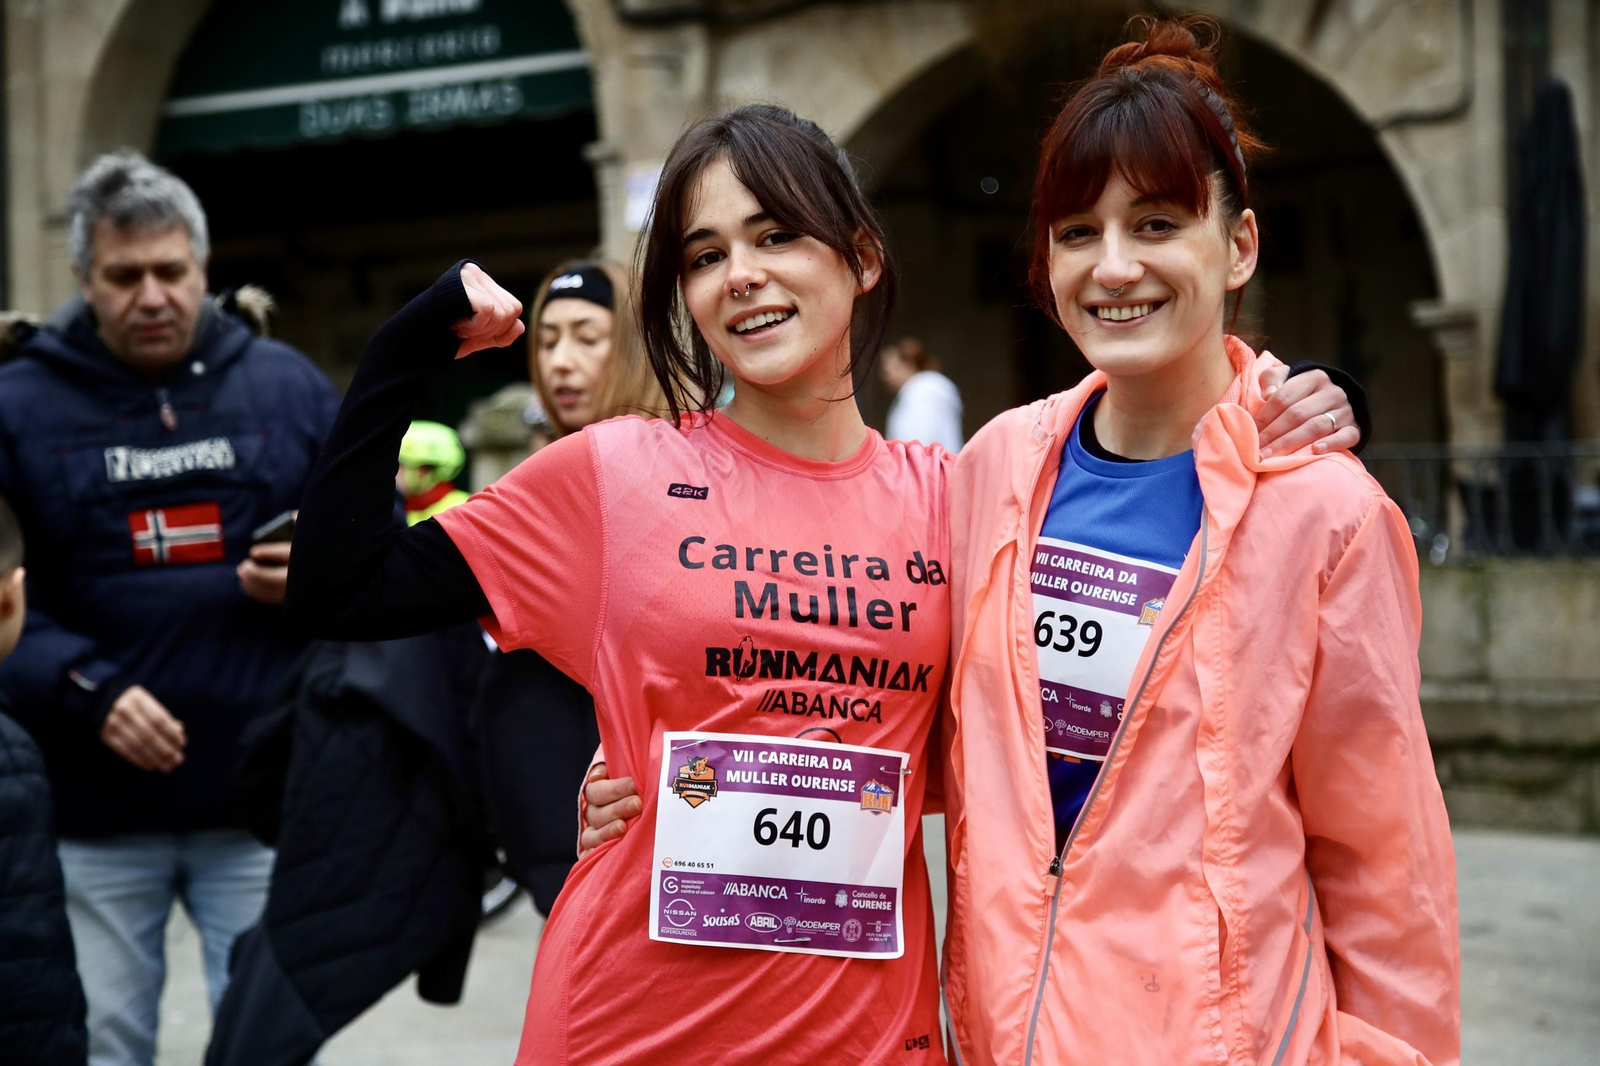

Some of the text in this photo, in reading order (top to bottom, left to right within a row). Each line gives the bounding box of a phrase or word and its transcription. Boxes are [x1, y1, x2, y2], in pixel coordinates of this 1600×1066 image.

[671, 486, 705, 497] 42K
[678, 535, 947, 586] Carreira da
[1035, 552, 1138, 585] VII CARREIRA DA
[1070, 581, 1138, 606] OURENSE
[733, 580, 918, 632] Muller
[1034, 610, 1103, 658] 639
[705, 646, 934, 693] RUNMANIAK
[1066, 724, 1109, 739] AODEMPER
[732, 749, 853, 772] VII CARREIRA DA
[726, 769, 856, 793] MULLER OURENSE
[862, 791, 891, 809] RUN
[753, 808, 831, 851] 640
[803, 896, 826, 905] inorde
[852, 890, 887, 900] Concello de
[852, 899, 892, 911] OURENSE
[663, 908, 697, 917] NISSAN
[750, 915, 778, 930] ABRIL
[796, 920, 841, 931] AODEMPER
